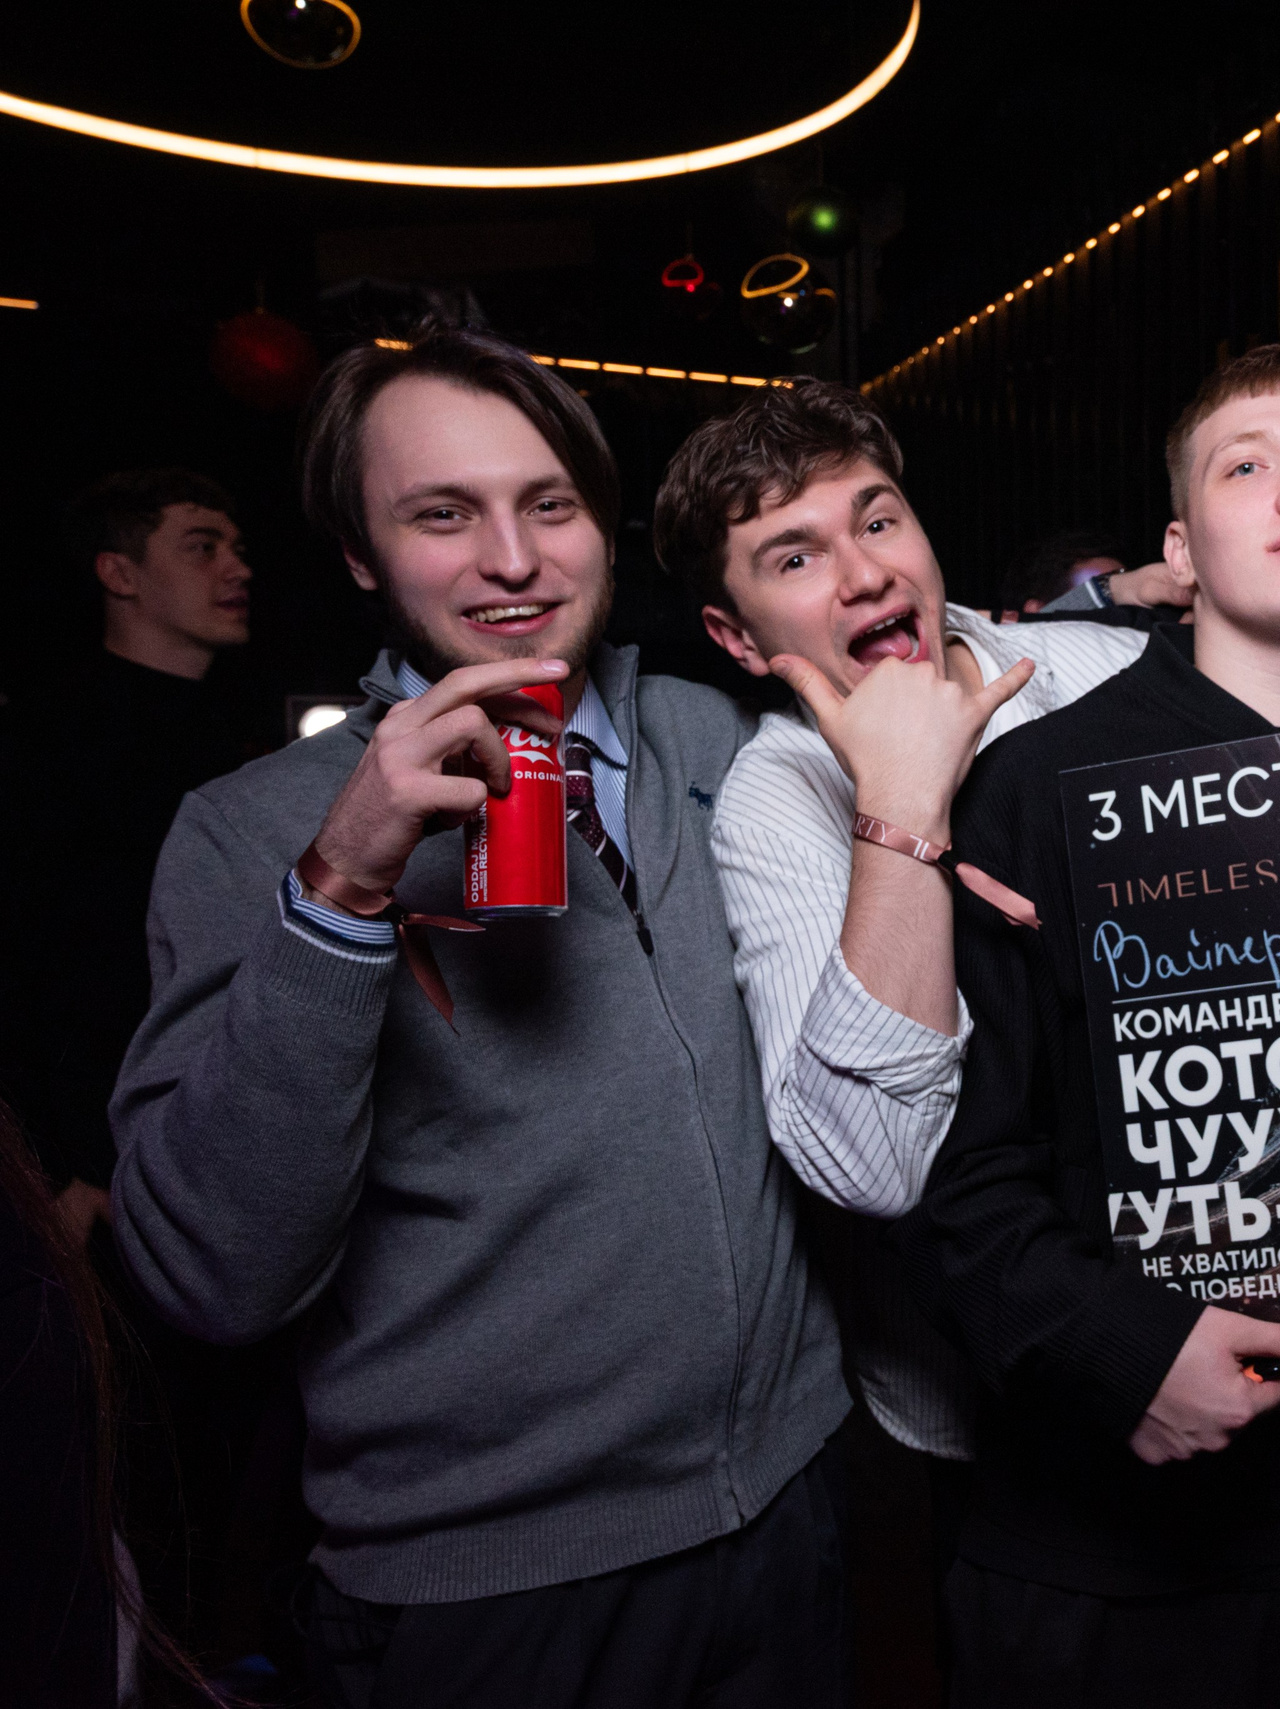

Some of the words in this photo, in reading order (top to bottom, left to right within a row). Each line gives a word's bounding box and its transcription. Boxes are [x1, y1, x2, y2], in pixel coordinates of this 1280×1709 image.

[469, 814, 480, 851] ME
[853, 815, 897, 843] RTY
[1088, 790, 1123, 842] 3
[470, 854, 480, 903] ODDAJ
[1142, 1256, 1173, 1279] НЕ
